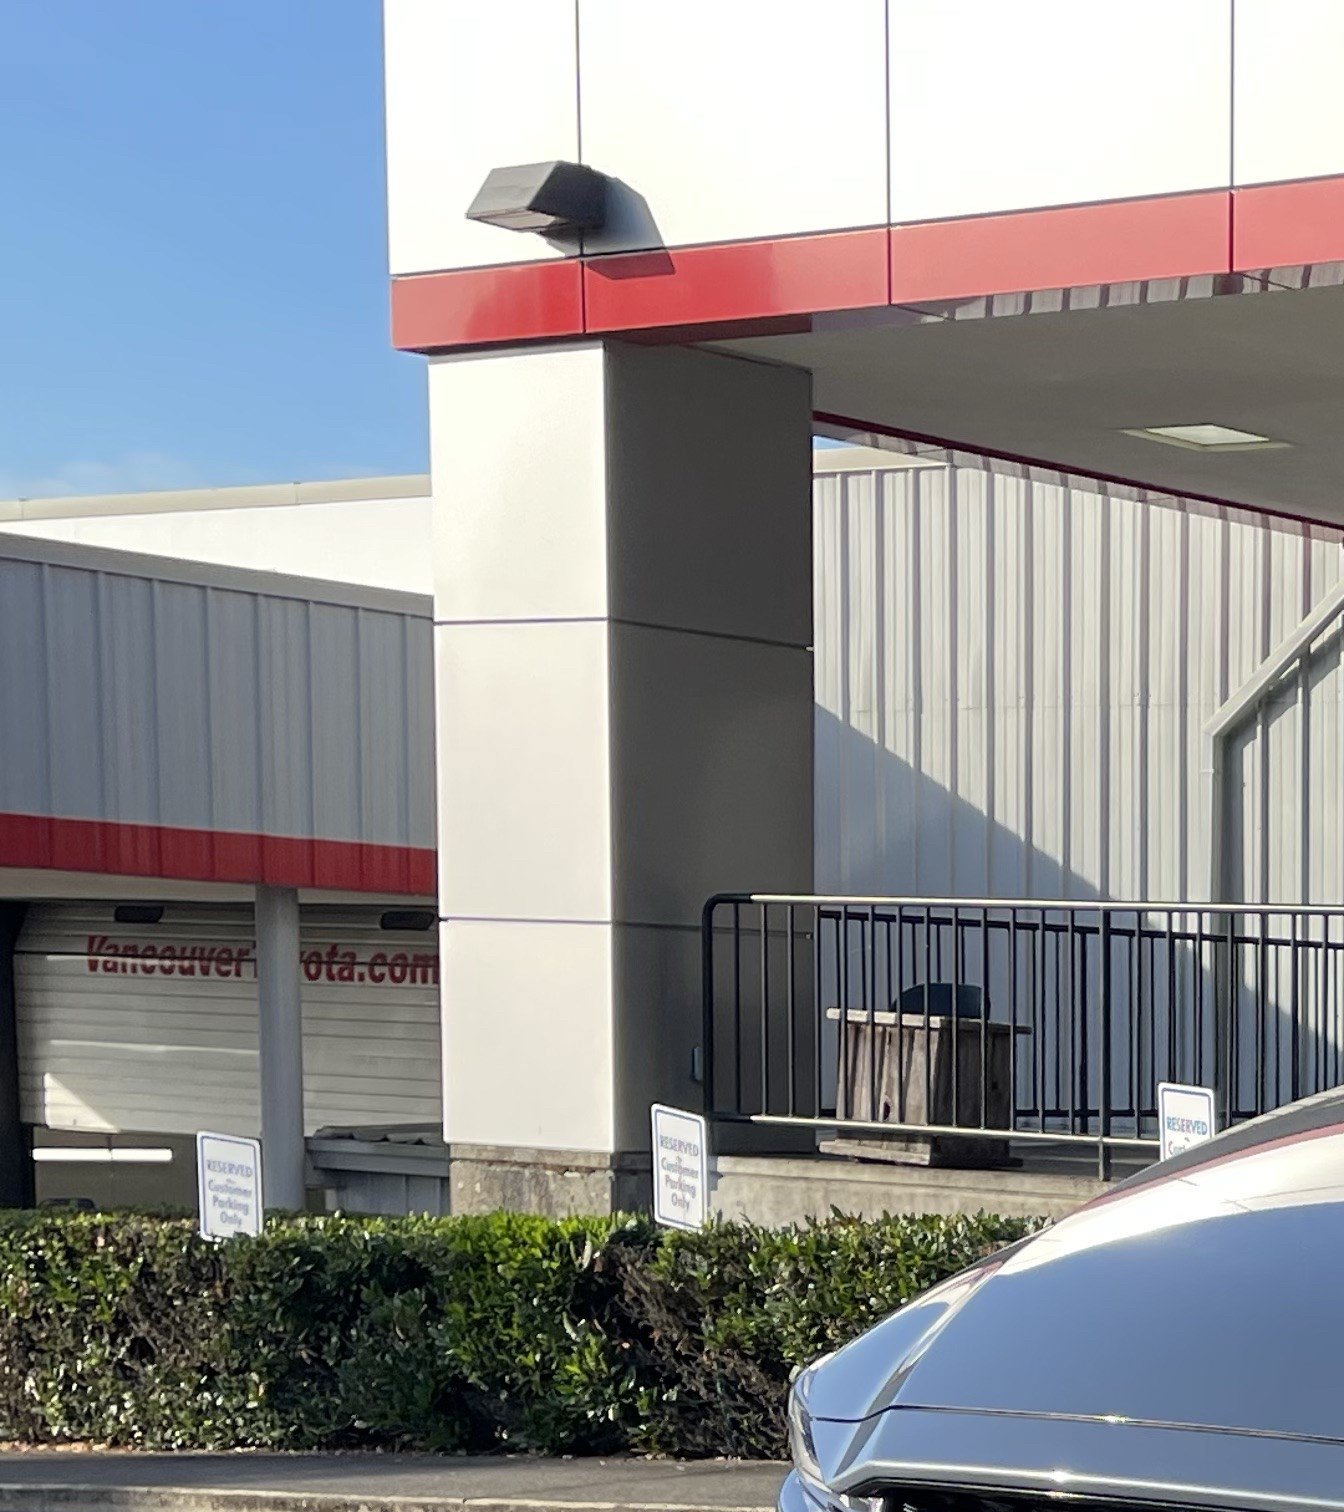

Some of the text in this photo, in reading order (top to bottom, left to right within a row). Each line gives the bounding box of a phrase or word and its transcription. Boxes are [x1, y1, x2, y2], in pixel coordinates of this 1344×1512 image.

[1166, 1115, 1208, 1136] RESERVED
[659, 1134, 699, 1157] RESERVED
[207, 1159, 253, 1178] RESERVED
